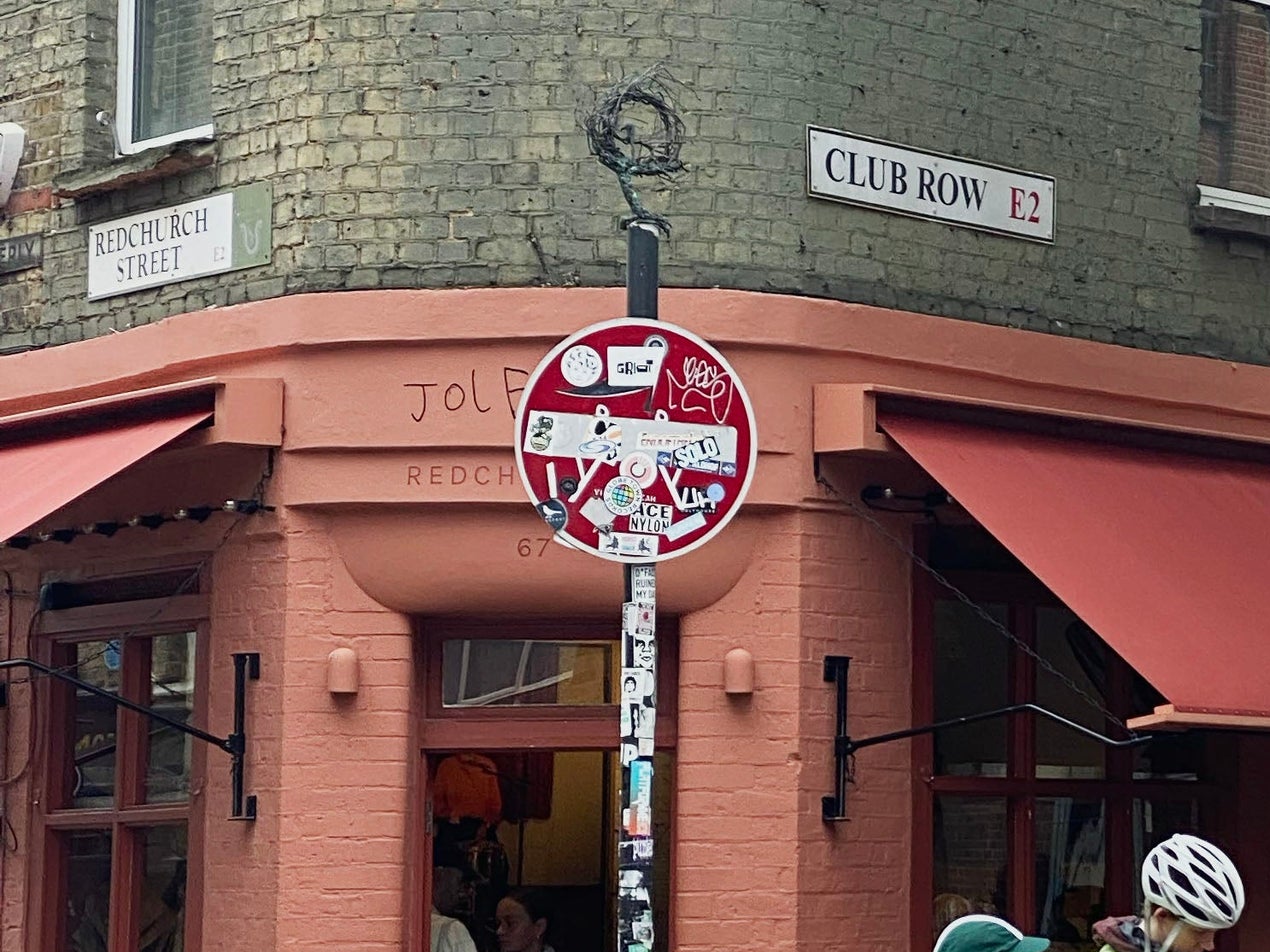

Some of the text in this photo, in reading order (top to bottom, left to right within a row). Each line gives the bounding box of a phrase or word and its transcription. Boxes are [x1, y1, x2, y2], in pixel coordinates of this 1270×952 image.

[825, 147, 1041, 224] CLUB ROW E2
[95, 207, 208, 257] REDCHURCH
[116, 244, 226, 283] STREET E2
[630, 516, 670, 533] NYLON
[516, 537, 550, 558] 67
